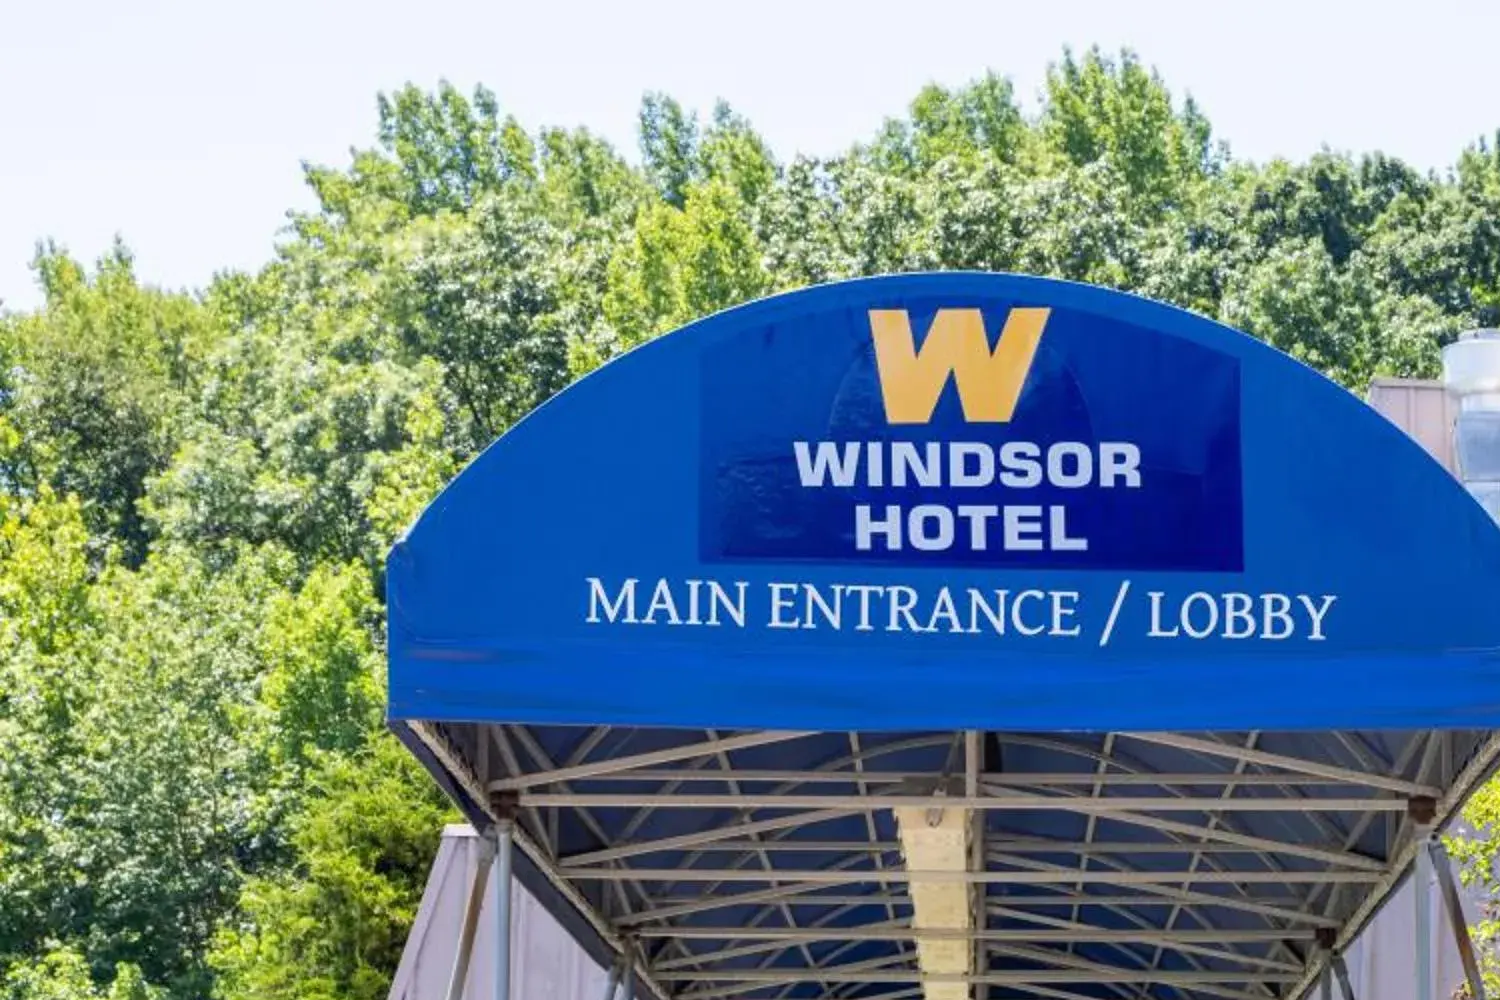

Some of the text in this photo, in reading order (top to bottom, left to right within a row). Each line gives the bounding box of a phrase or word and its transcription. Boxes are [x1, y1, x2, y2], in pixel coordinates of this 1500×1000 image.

[868, 308, 1050, 424] W
[794, 442, 1141, 488] WINDSOR
[855, 505, 1088, 551] HOTEL
[585, 578, 1336, 646] MAIN ENTRANCE / LOBBY
